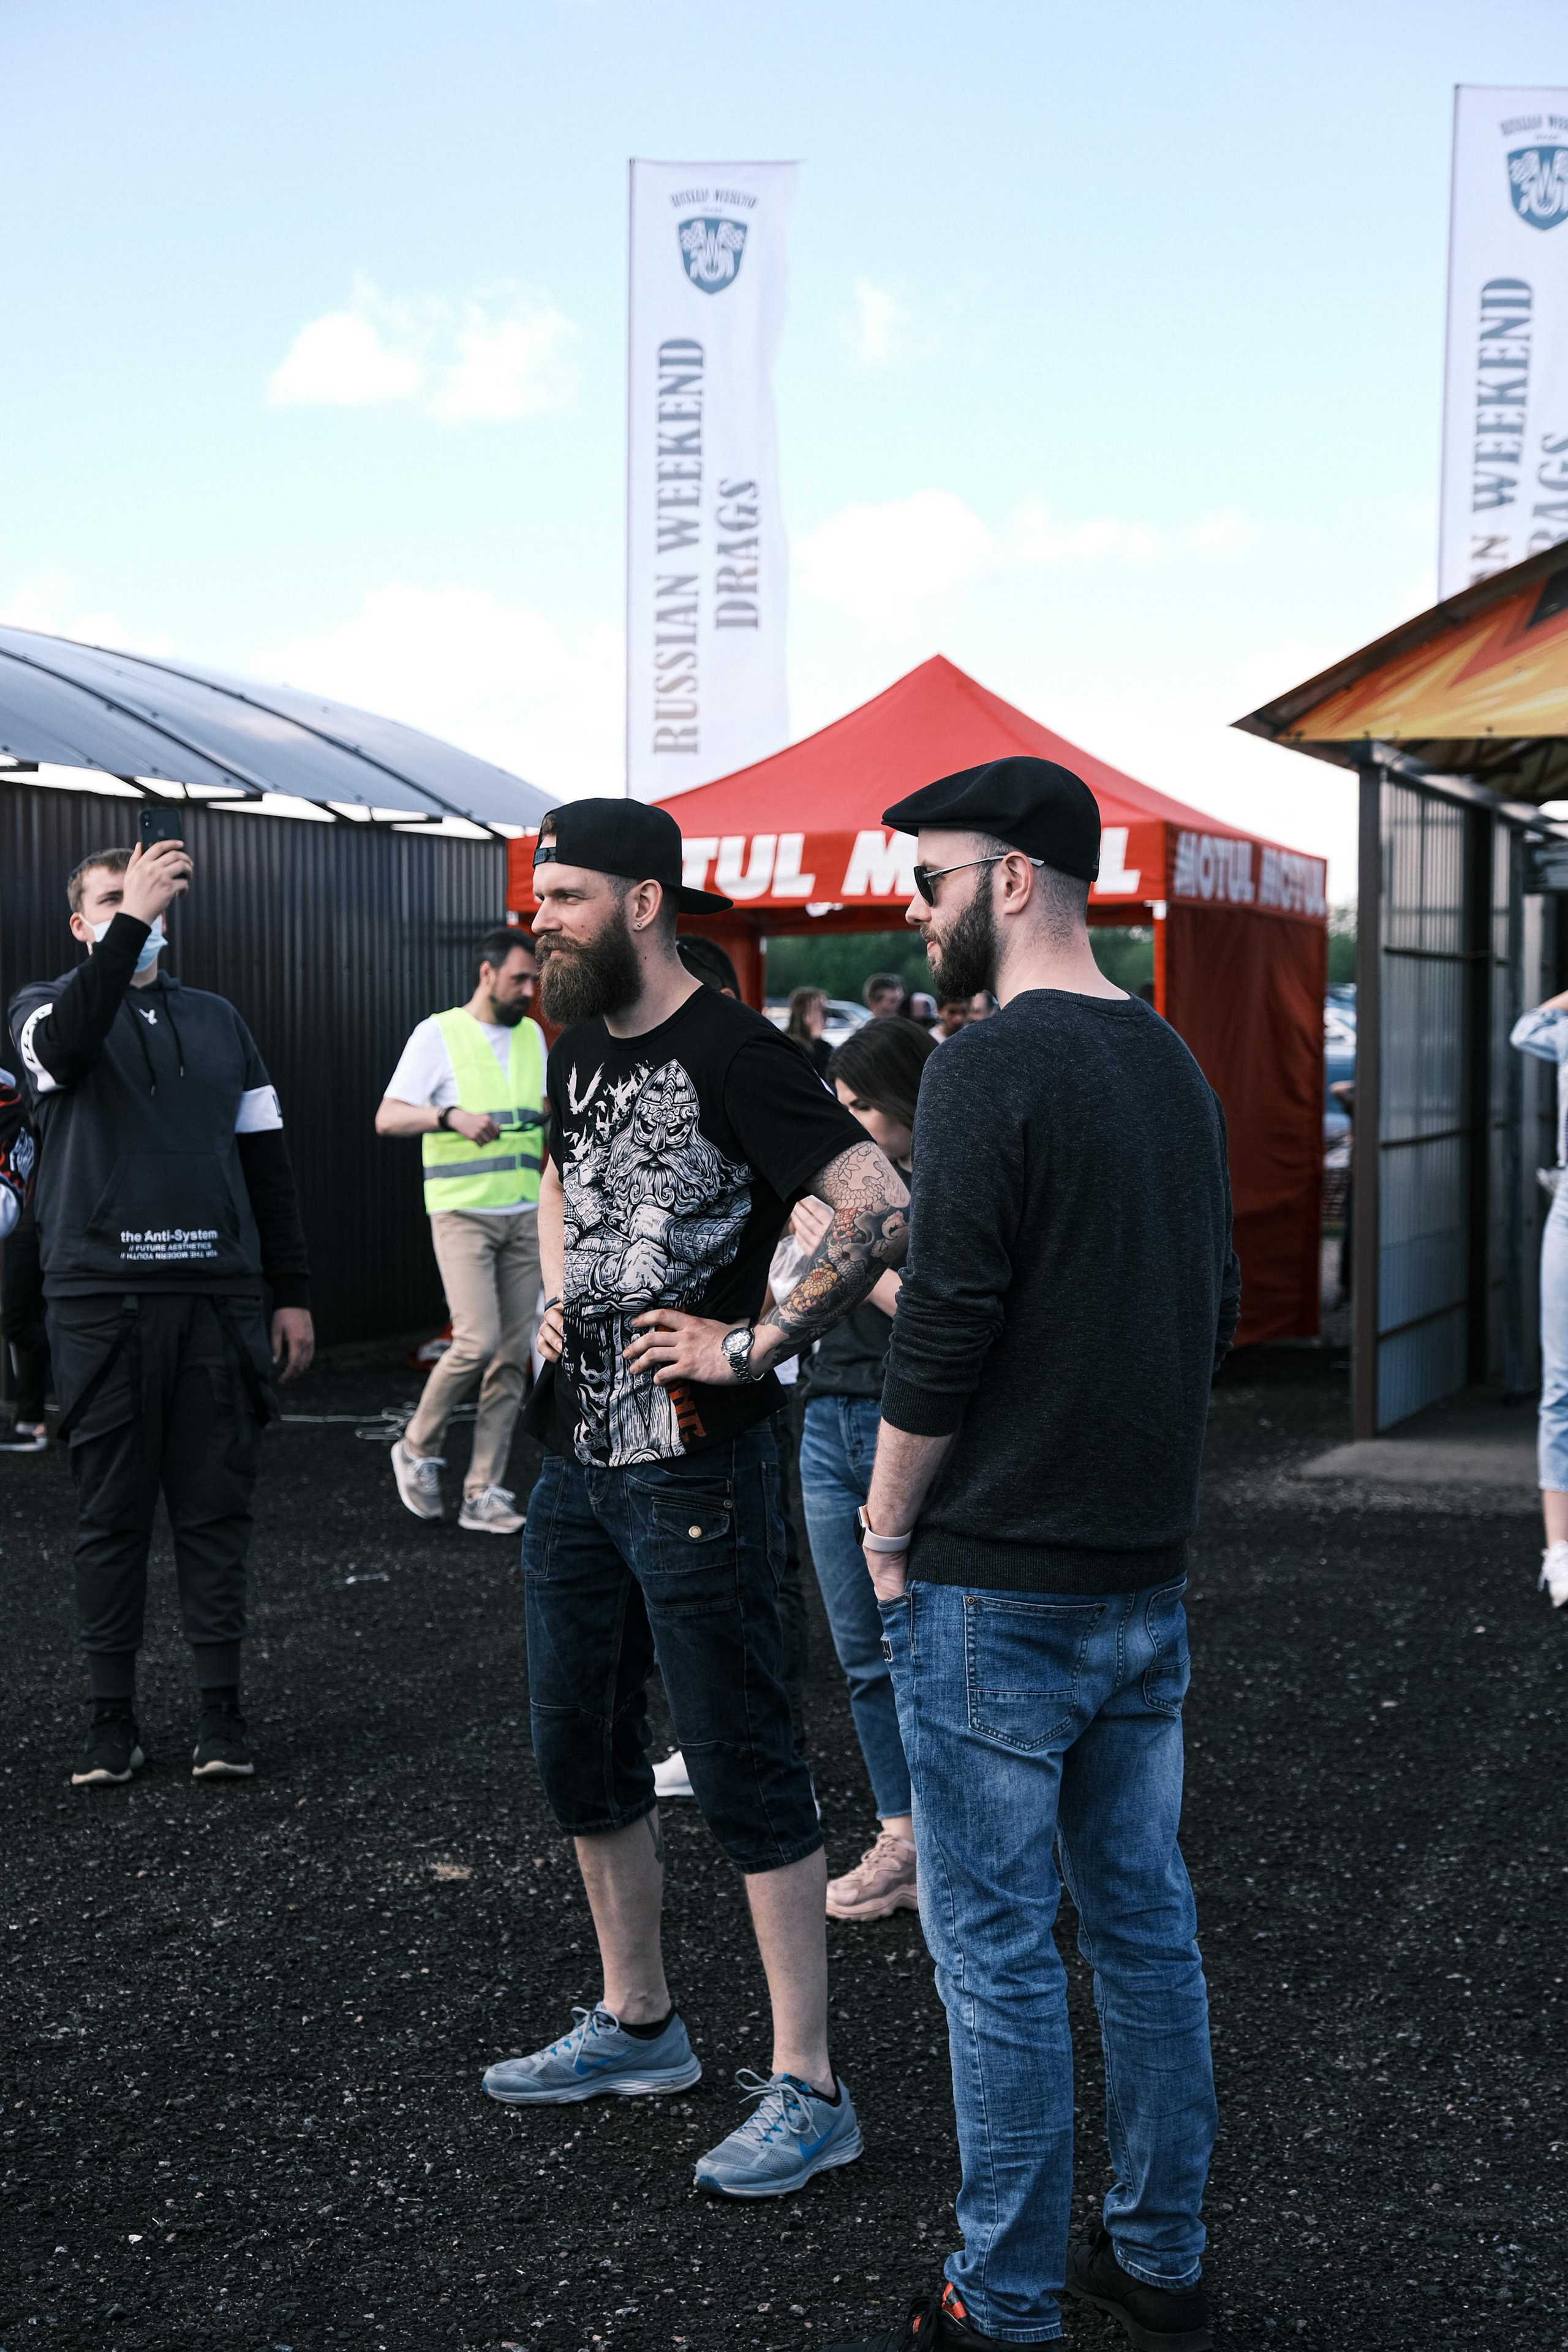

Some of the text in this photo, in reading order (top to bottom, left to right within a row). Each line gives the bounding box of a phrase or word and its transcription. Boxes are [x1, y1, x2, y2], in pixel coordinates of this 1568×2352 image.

[1472, 277, 1533, 512] WEEKEND
[653, 339, 704, 754] RUSSIAN WEEKEND
[715, 478, 760, 630] DRAGS
[681, 832, 816, 900] TUL
[1173, 831, 1255, 903] MOTUL
[120, 1229, 217, 1245] the Anti-System
[126, 1252, 155, 1261] YOUTH
[135, 1243, 166, 1252] FUTURE
[168, 1242, 211, 1251] AESTHETICS
[155, 1251, 189, 1260] MODERN
[189, 1250, 205, 1259] THE
